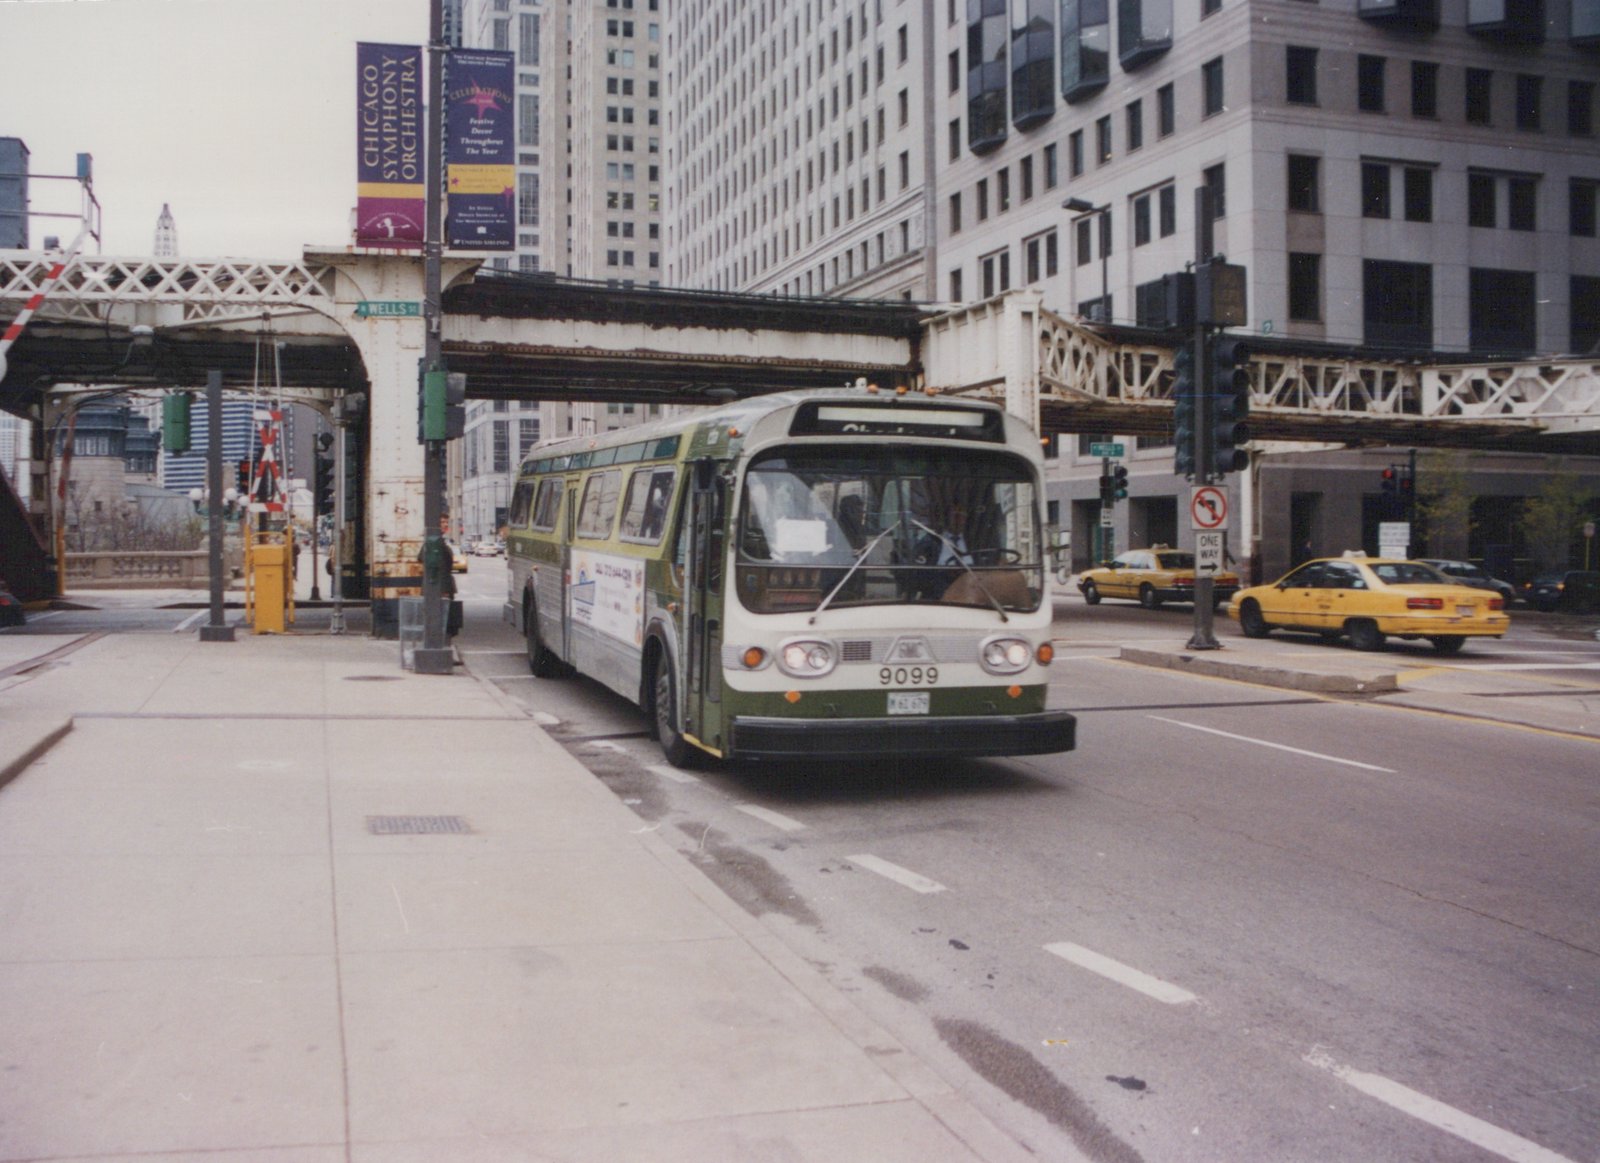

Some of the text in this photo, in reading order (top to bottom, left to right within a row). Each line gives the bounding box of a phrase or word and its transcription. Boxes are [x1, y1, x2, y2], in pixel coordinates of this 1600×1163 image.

[364, 65, 379, 167] CHICAGO
[383, 56, 398, 179] SYMPHONY
[401, 56, 417, 180] ORCHESTRA
[460, 138, 504, 147] Throughout
[368, 303, 407, 315] WELLS
[1200, 535, 1219, 547] ONE
[1200, 549, 1219, 559] WAY
[879, 667, 939, 685] 9099
